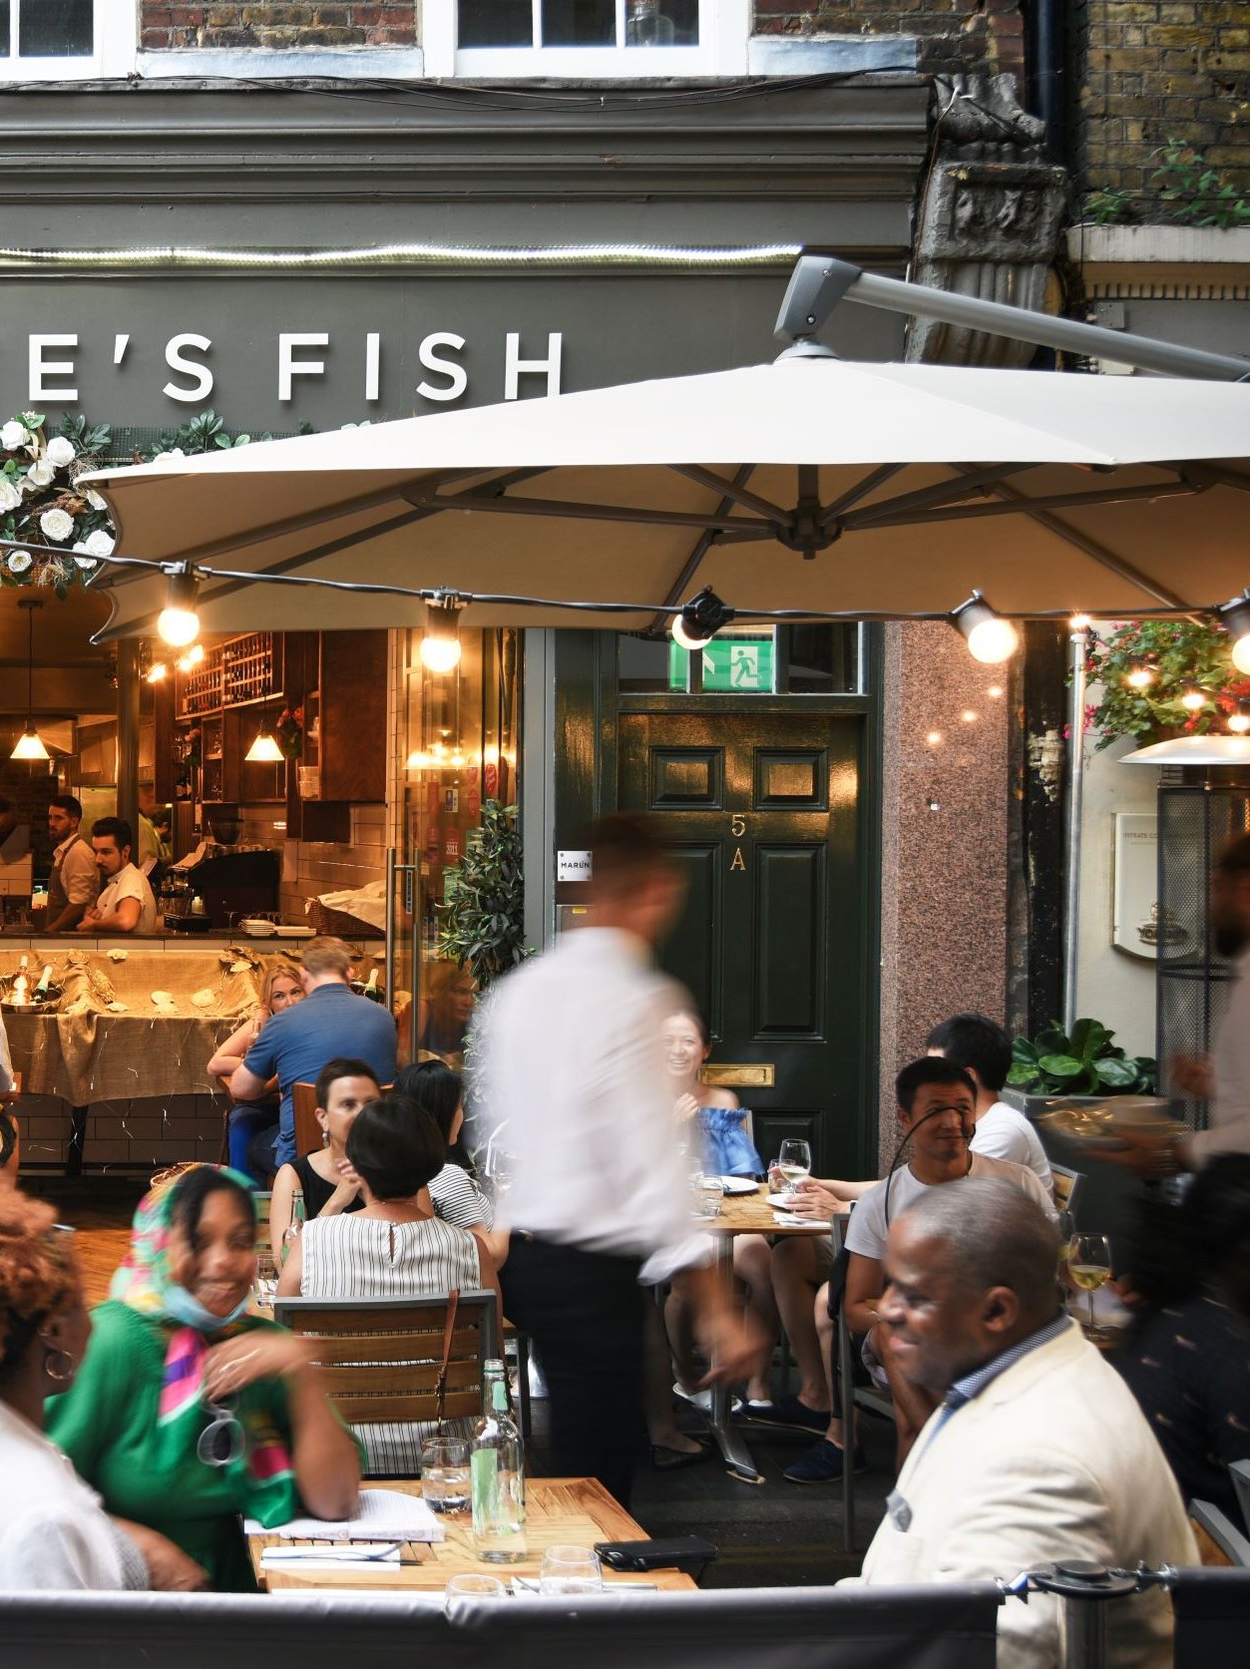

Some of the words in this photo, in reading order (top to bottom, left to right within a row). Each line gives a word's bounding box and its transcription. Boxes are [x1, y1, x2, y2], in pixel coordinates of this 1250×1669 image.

[278, 332, 564, 402] FISH
[731, 814, 746, 837] 5
[730, 847, 746, 871] A
